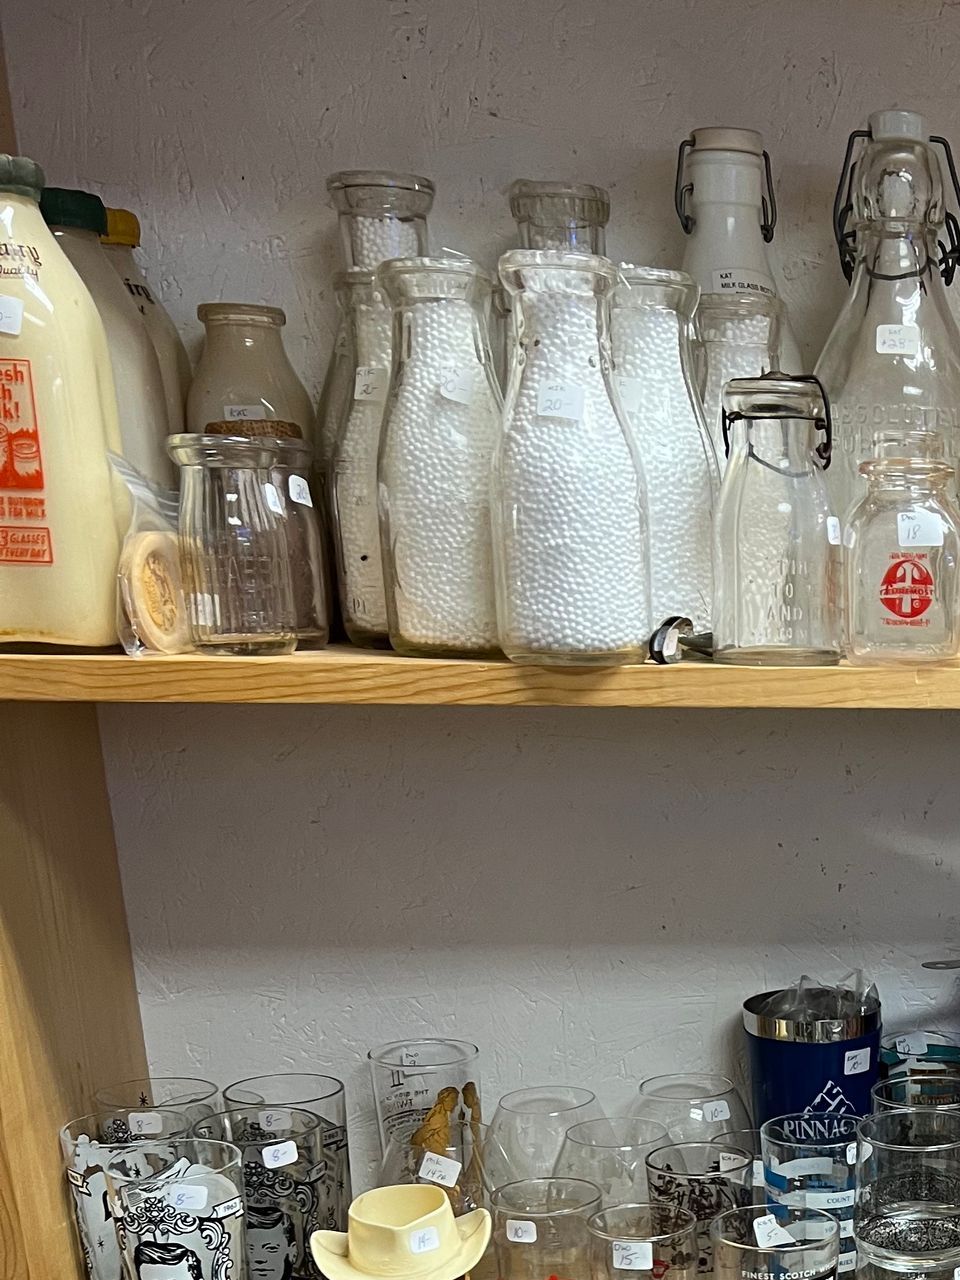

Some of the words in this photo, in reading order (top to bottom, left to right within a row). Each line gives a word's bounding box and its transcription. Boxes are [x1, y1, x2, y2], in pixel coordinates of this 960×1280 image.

[0, 363, 24, 383] esh
[783, 1114, 870, 1141] PINNAC
[742, 1270, 775, 1280] FINEST
[779, 1268, 816, 1280] SCOTCH
